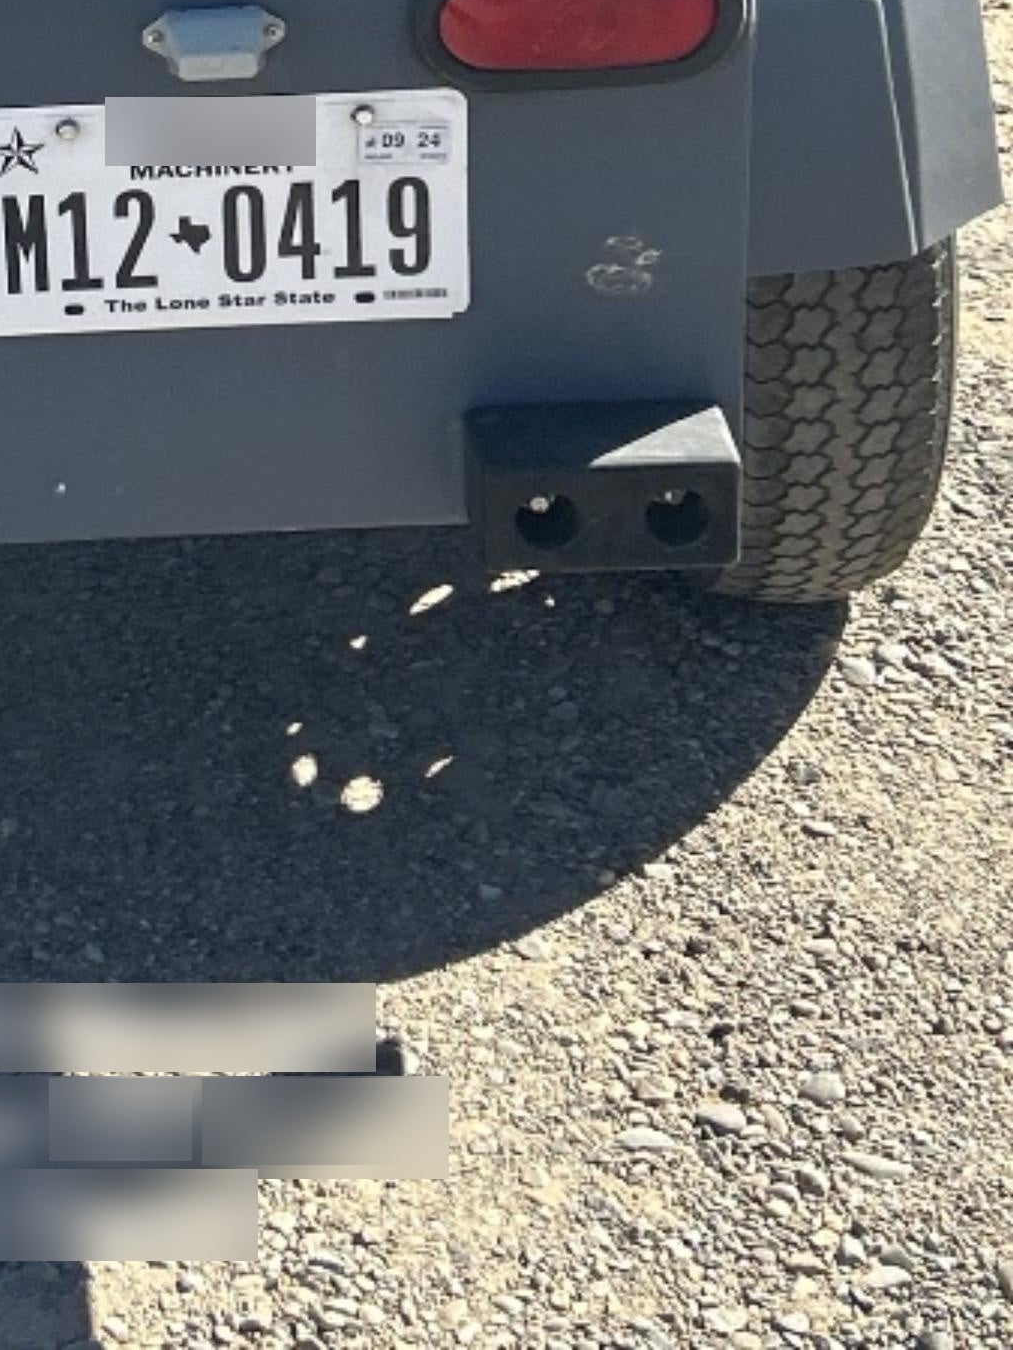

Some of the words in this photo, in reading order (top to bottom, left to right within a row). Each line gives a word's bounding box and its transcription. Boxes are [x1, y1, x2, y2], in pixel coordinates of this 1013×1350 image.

[381, 131, 406, 149] 09
[418, 131, 442, 148] 24
[1, 188, 159, 295] M12
[221, 176, 432, 283] 0419
[104, 298, 147, 314] The
[155, 296, 211, 311] Lone
[218, 293, 266, 308] Star
[274, 291, 336, 306] State
